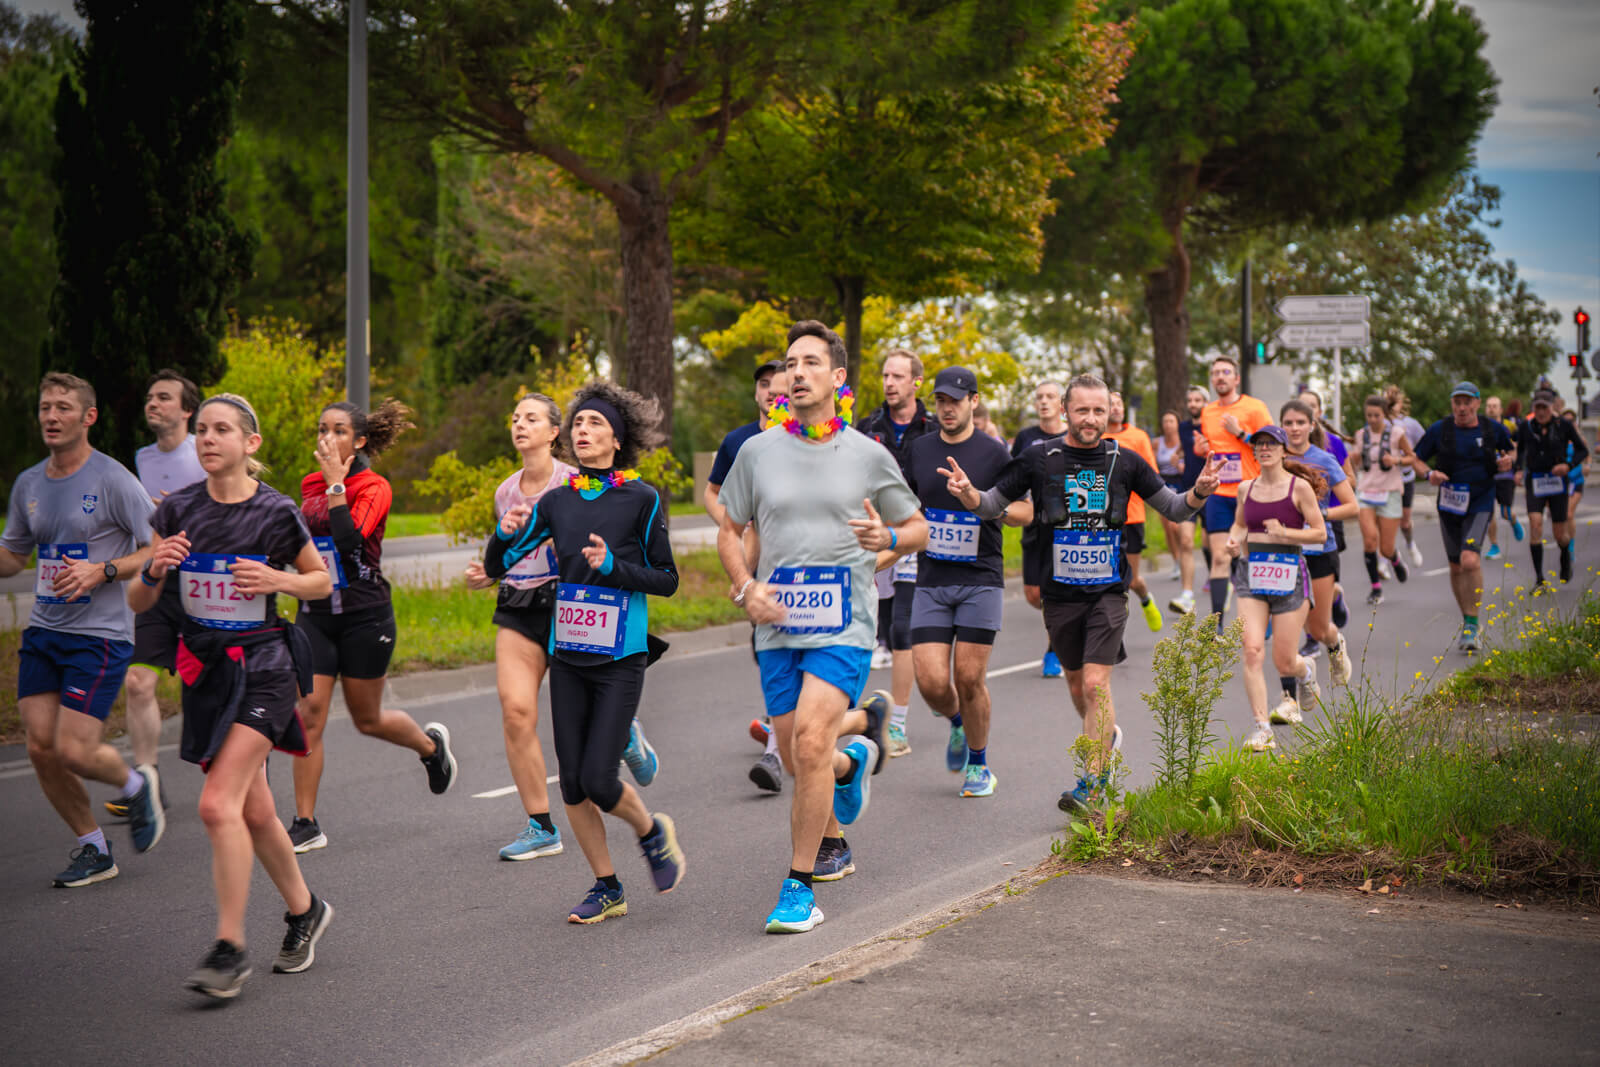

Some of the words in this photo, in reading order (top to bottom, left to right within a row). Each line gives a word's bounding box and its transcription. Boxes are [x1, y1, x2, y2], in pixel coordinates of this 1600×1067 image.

[929, 526, 973, 543] 21512
[1060, 549, 1107, 565] 20550
[1252, 565, 1290, 579] 22701
[775, 591, 833, 608] 20280
[558, 607, 608, 628] 20281
